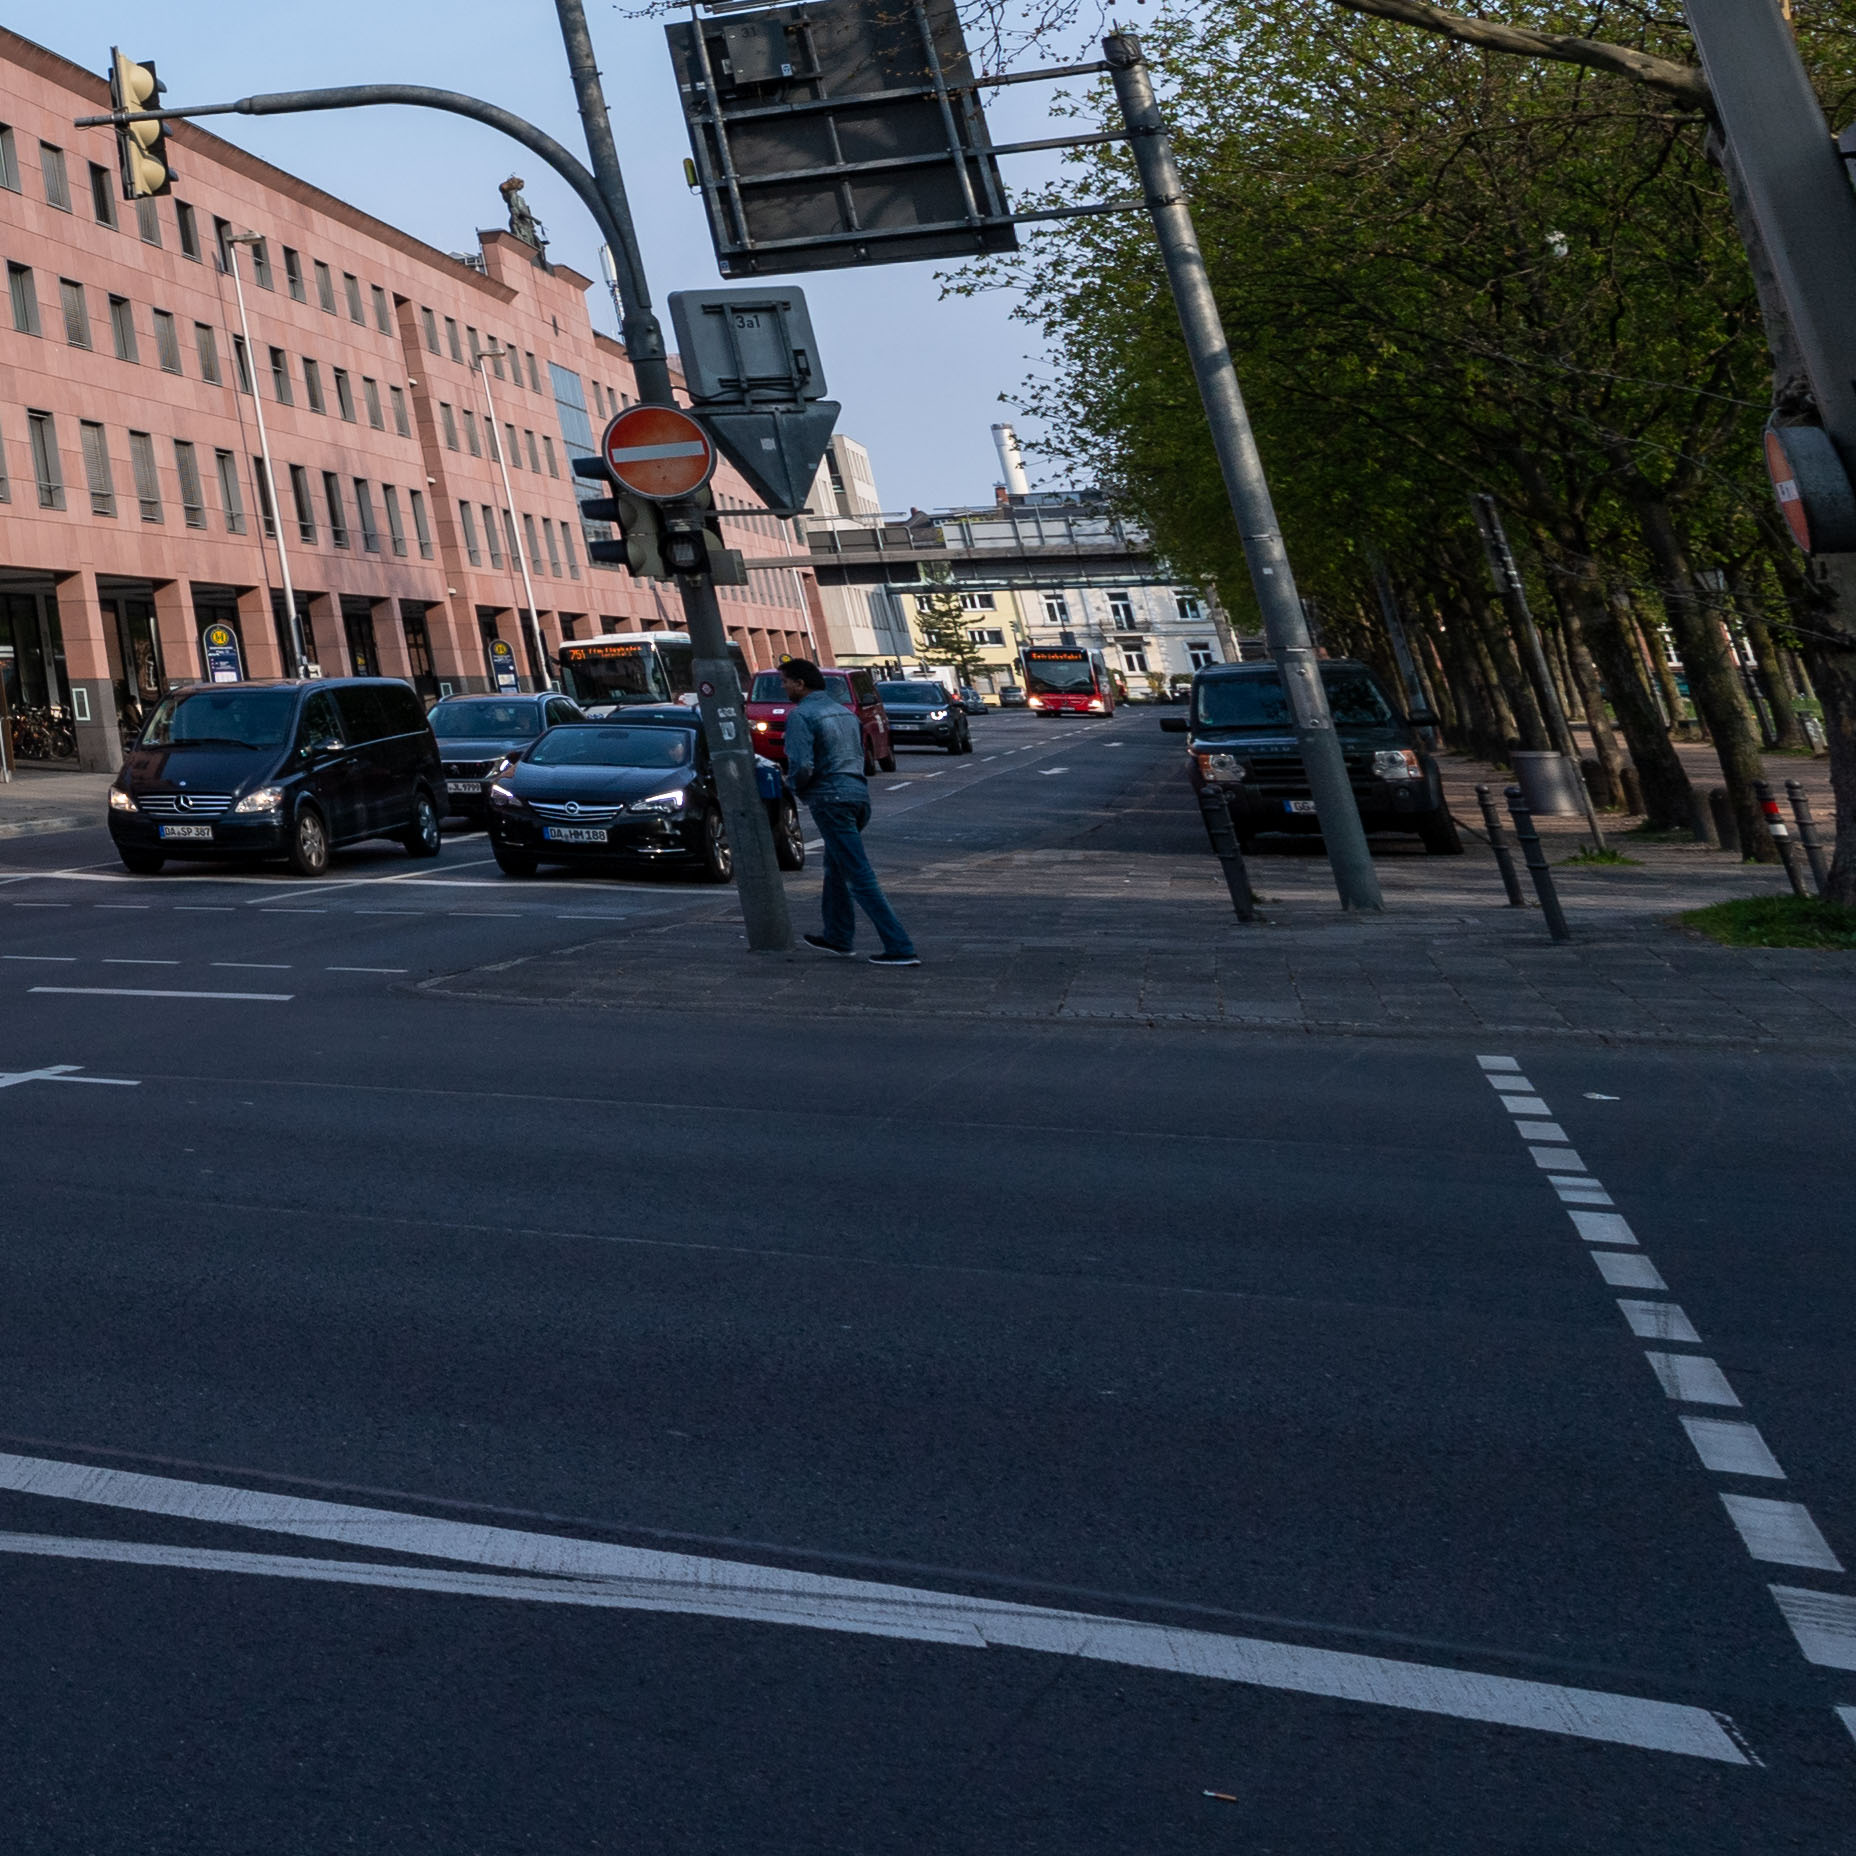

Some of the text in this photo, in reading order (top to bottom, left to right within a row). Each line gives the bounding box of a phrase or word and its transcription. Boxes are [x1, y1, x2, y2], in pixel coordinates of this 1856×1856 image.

[735, 315, 760, 329] 3a1
[570, 649, 586, 660] 751
[164, 826, 177, 836] DA
[180, 826, 193, 837] SP
[549, 829, 607, 841] DA HM 188
